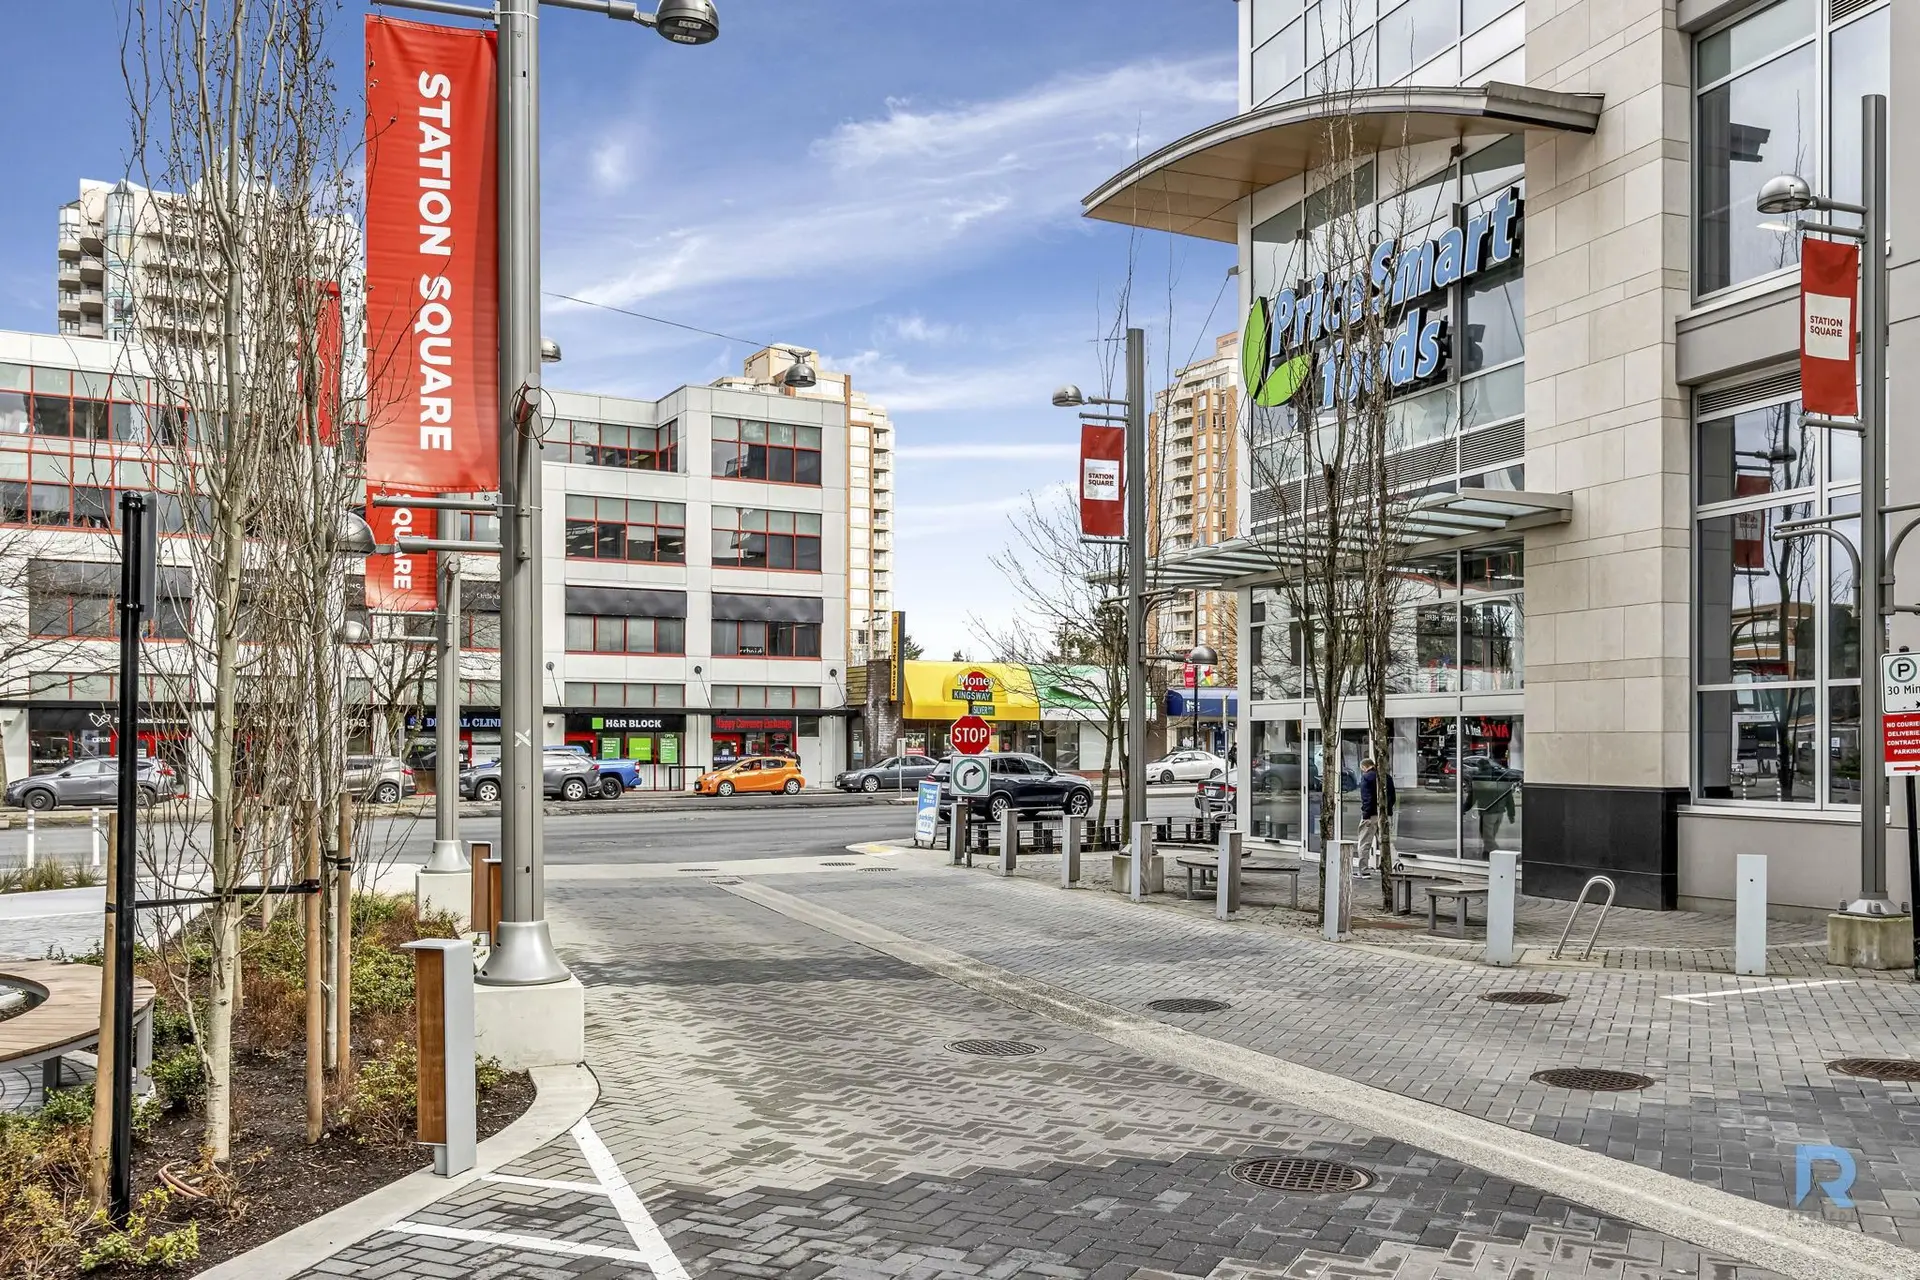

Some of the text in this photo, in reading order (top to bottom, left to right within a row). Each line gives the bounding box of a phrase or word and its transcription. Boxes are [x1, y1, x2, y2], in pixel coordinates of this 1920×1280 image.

[413, 70, 453, 452] STATION SQUARE
[1810, 315, 1843, 328] STATION
[1810, 326, 1843, 338] SQUARE
[1088, 472, 1115, 480] STATION
[1088, 479, 1115, 487] SQUARE
[957, 674, 996, 690] Money
[953, 690, 991, 701] KINGSWAY
[1887, 686, 1900, 696] 30
[972, 705, 988, 714] SILVER
[471, 717, 502, 727] CLINI
[605, 719, 662, 728] H&R BLOCK
[715, 717, 793, 731] Happy Currency Exchange
[954, 727, 988, 743] STOP
